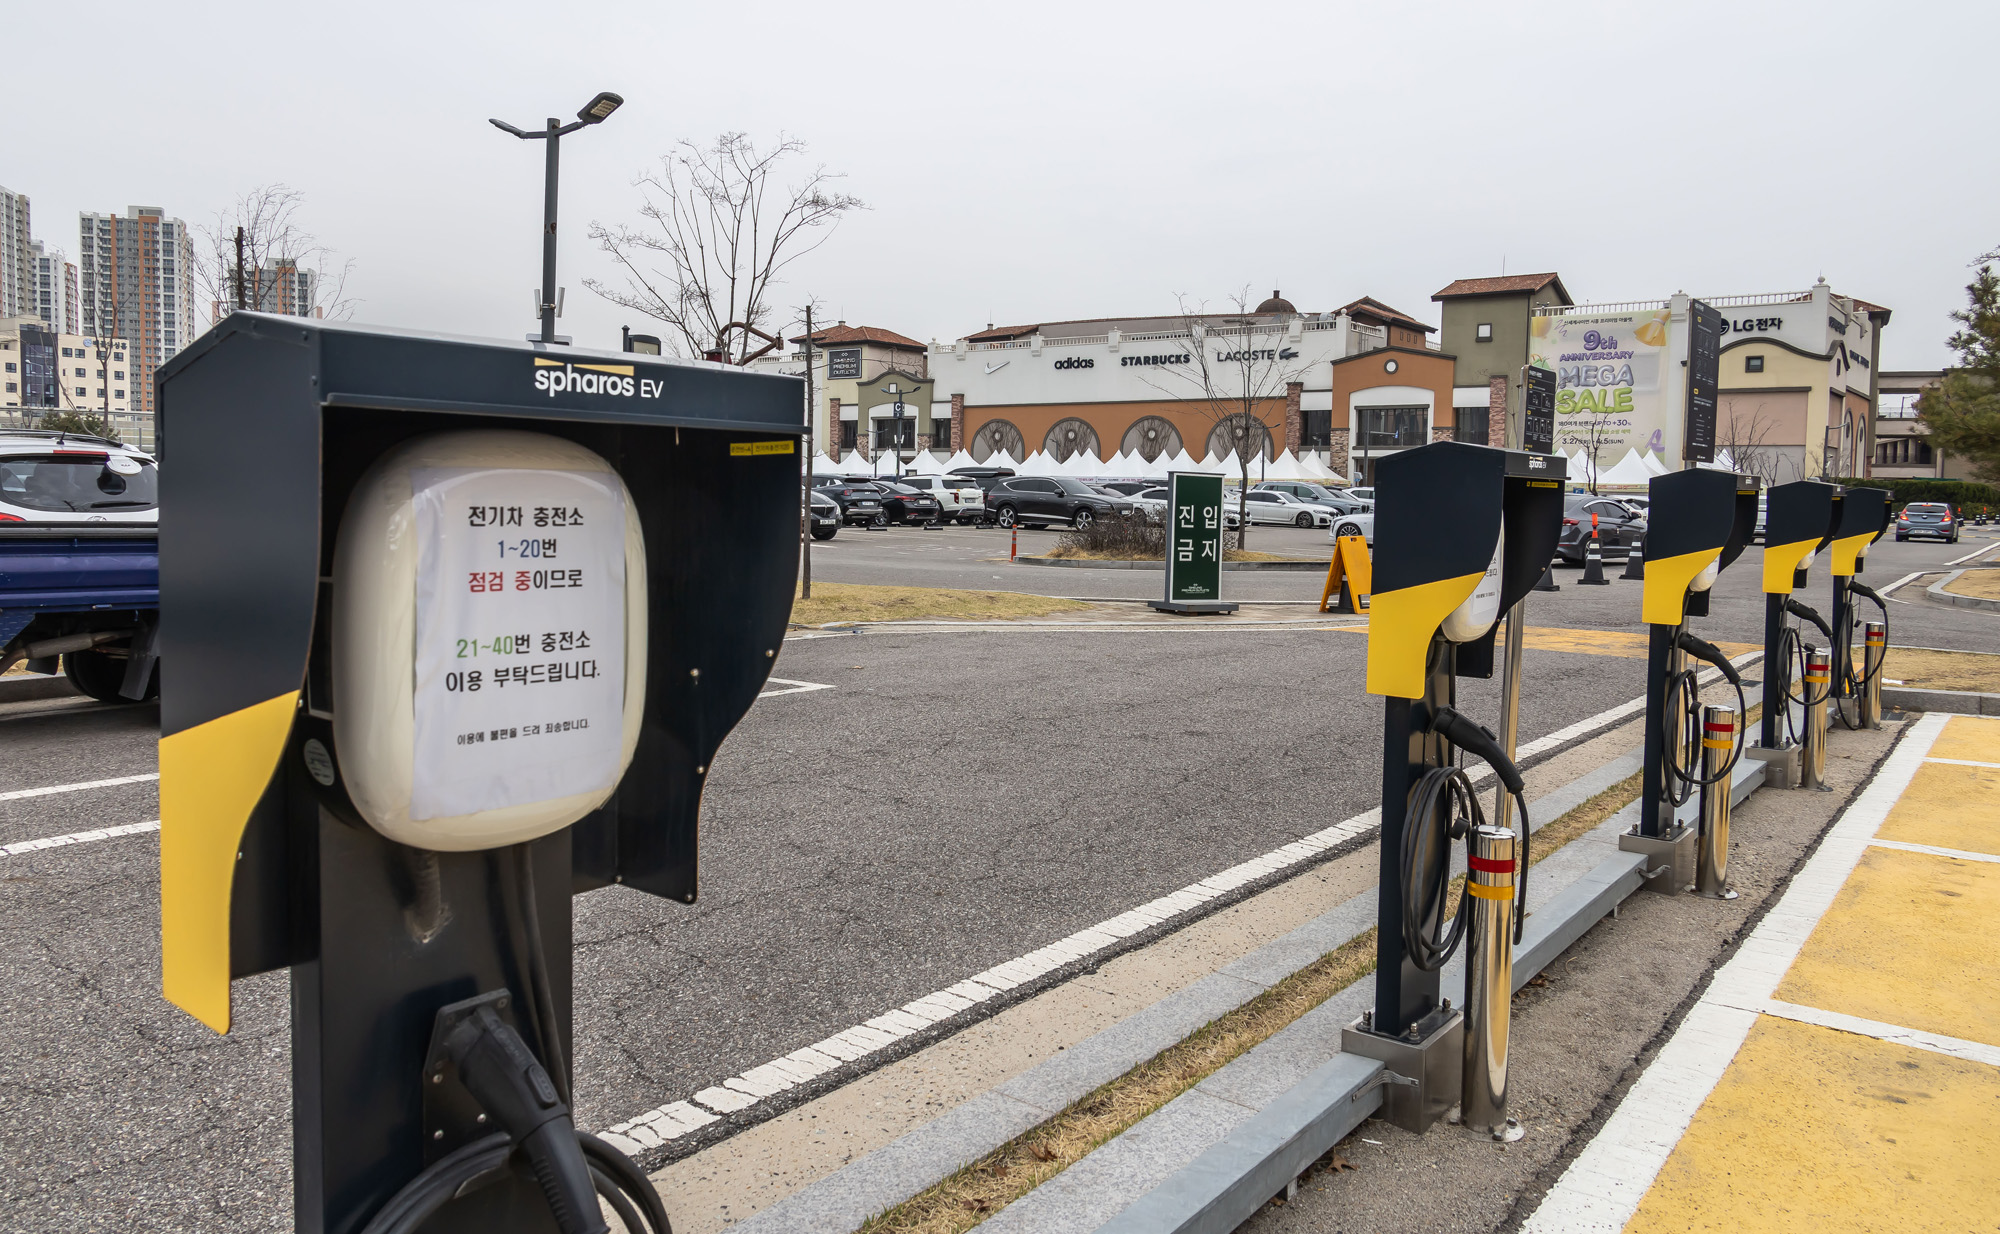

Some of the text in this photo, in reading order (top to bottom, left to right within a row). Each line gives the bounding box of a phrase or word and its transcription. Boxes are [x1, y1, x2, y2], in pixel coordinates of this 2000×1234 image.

[1733, 317, 1783, 332] LG전자
[1583, 329, 1618, 351] 9th
[1054, 357, 1094, 370] adidas
[1120, 353, 1191, 367] STARBUCKS
[1217, 349, 1275, 362] LACOSTE
[1559, 350, 1634, 363] ANNIVERSARY
[534, 363, 664, 399] spharos EV
[1558, 363, 1634, 389] MEGA
[1556, 387, 1634, 415] SALE
[468, 506, 584, 528] 전기차 충전소
[498, 538, 557, 559] 1~20번
[468, 569, 583, 593] 점검 중이므로
[456, 630, 591, 659] 21~40번 충전소
[445, 660, 600, 693] 이용 부탁드립니다.
[457, 718, 590, 745] 이용에 불편을 드려 죄송합니다.
